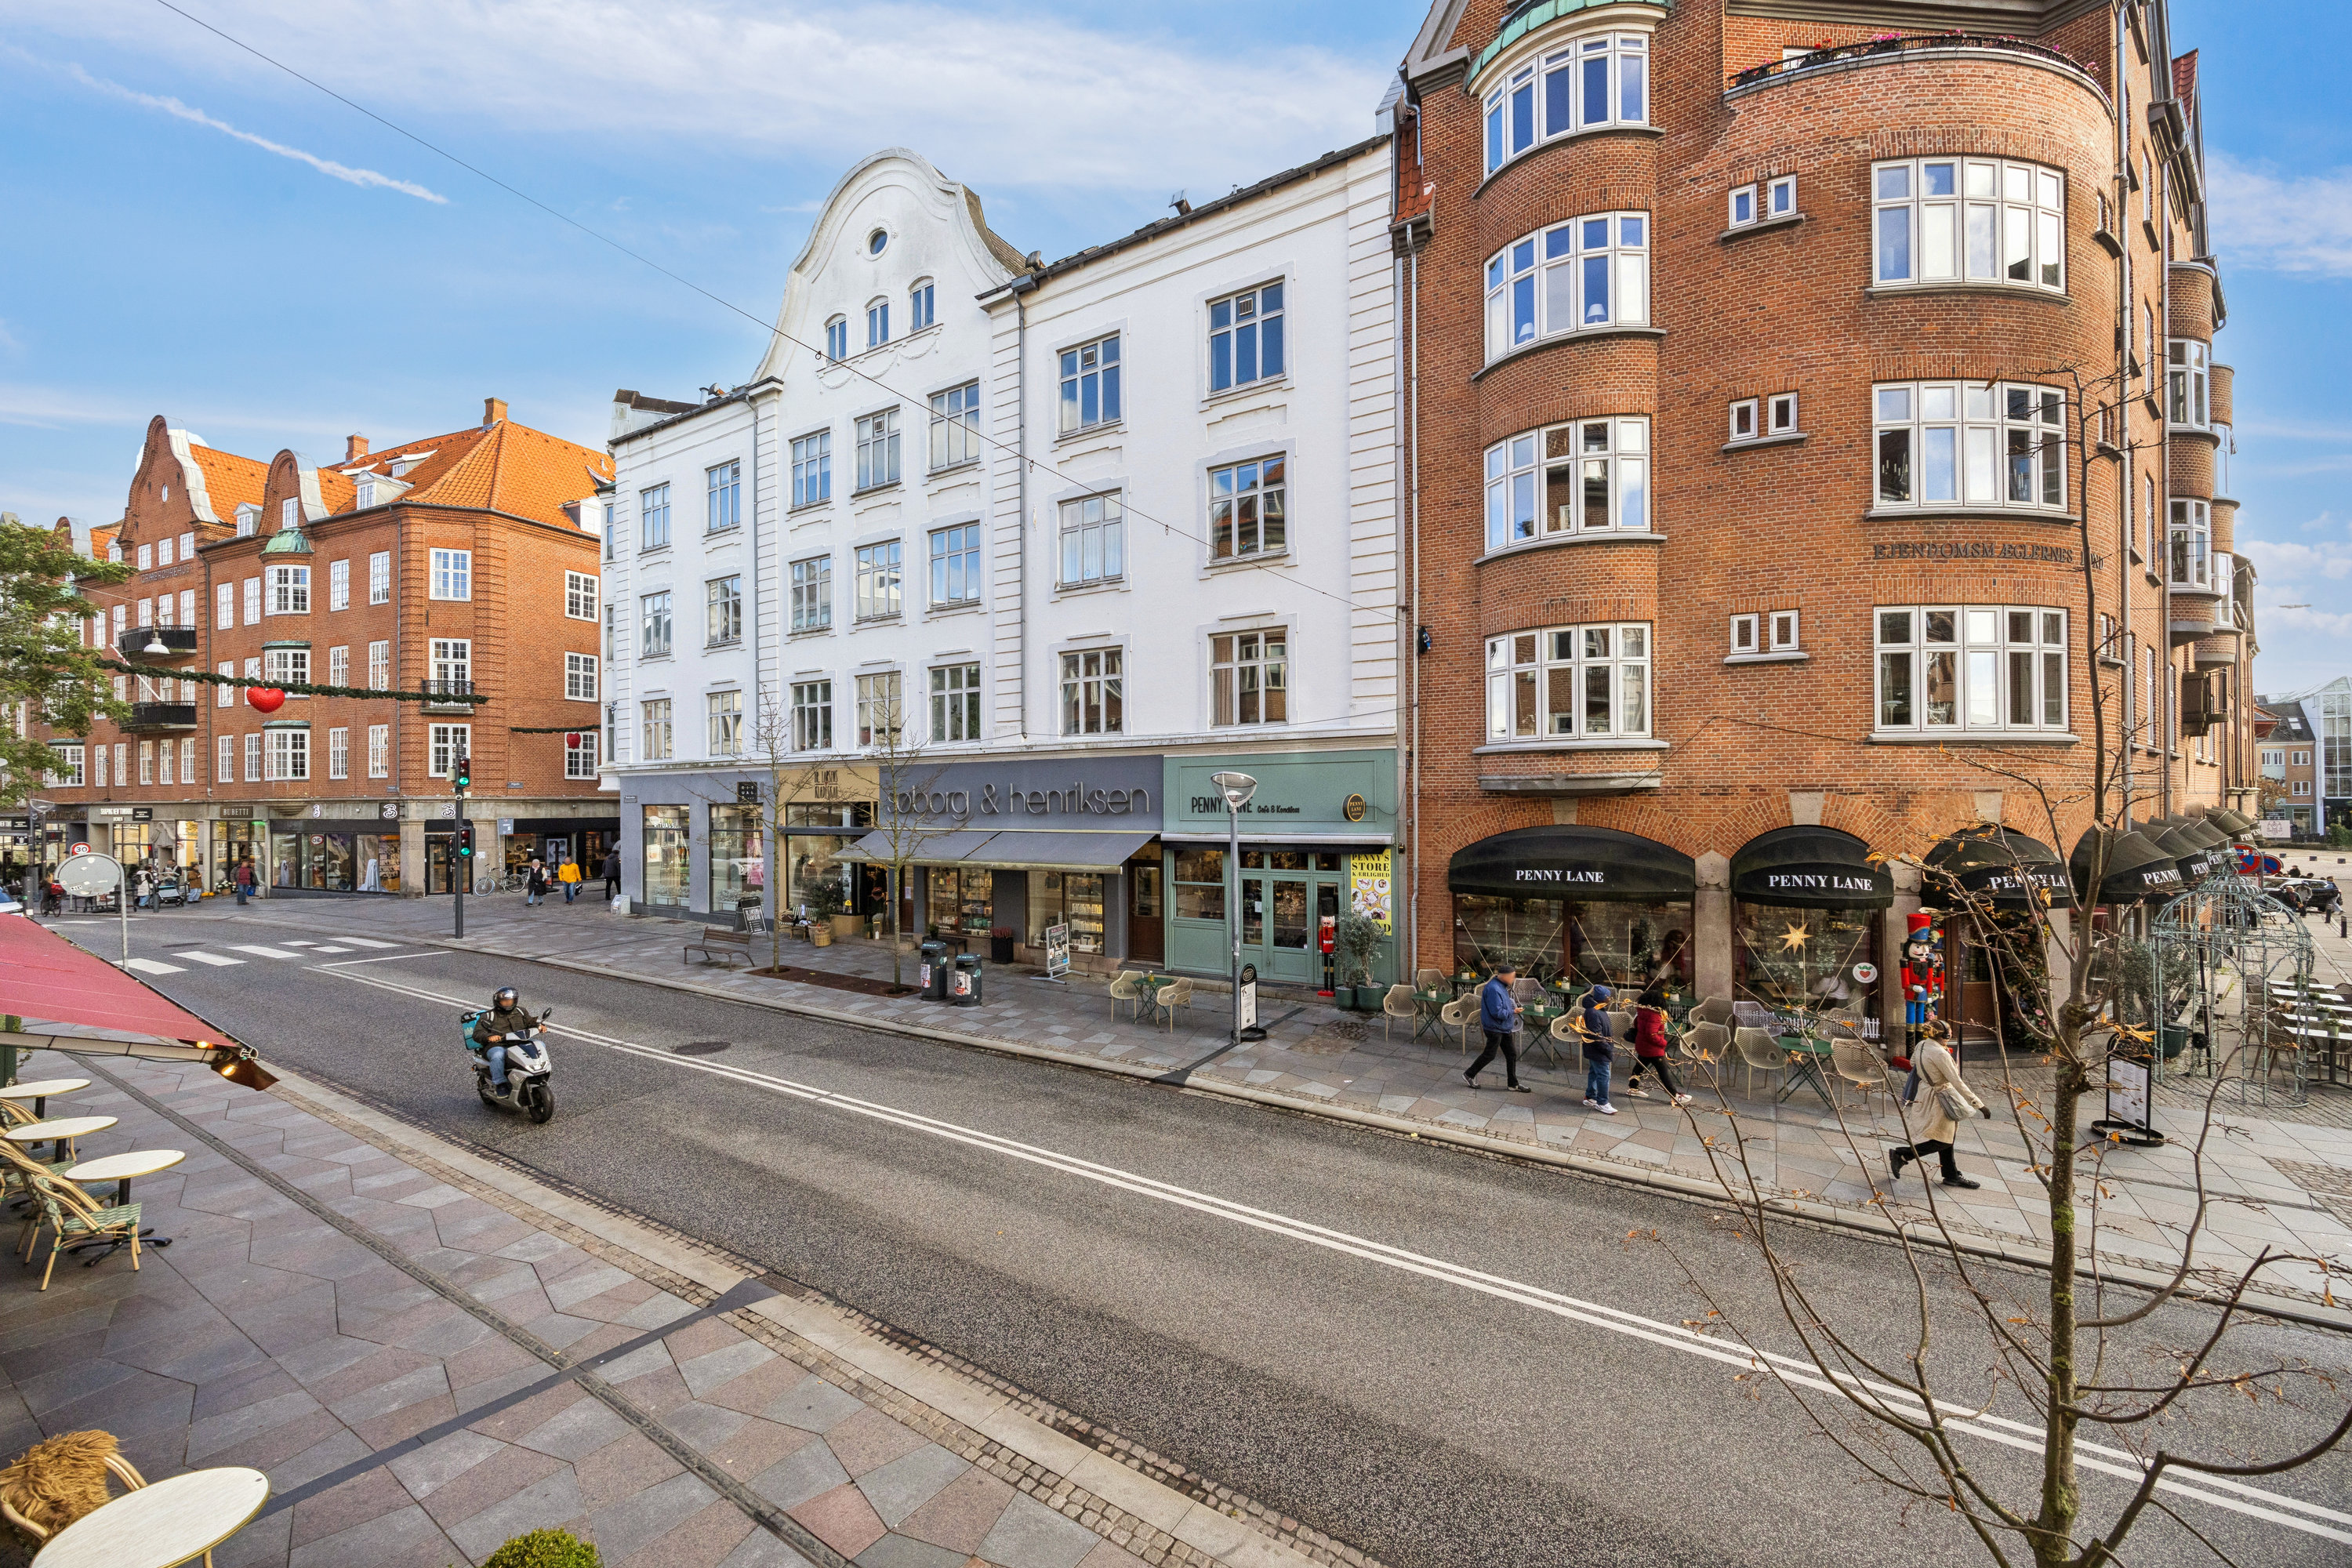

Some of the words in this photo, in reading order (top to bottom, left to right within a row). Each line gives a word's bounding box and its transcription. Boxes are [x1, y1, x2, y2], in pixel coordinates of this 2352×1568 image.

[887, 785, 970, 821] søborg
[980, 783, 1000, 815] &
[1010, 781, 1150, 815] henriksen
[1192, 797, 1222, 814] PENNY
[1352, 862, 1389, 872] STORE
[1515, 869, 1563, 880] PENNY
[1566, 870, 1604, 883] LANE
[1769, 875, 1828, 887] PENNY
[1832, 876, 1873, 891] LANE
